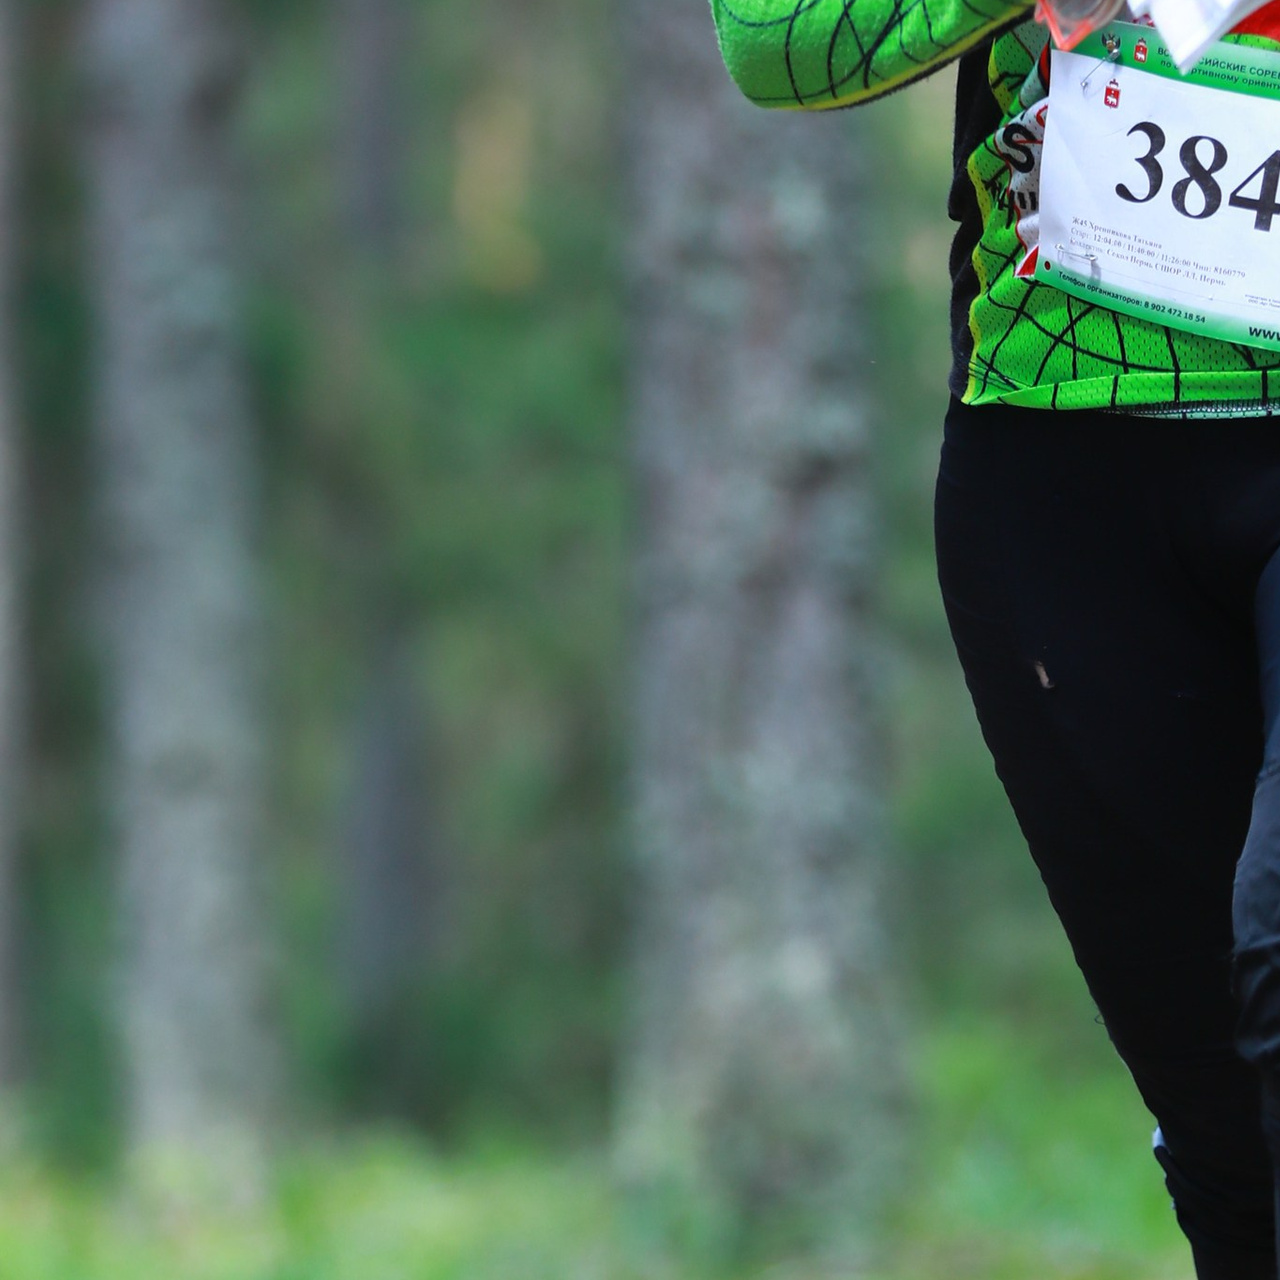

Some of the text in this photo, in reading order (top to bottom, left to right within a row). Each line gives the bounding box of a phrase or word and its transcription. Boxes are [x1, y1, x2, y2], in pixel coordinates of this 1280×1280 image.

[1160, 59, 1172, 68] по
[1058, 271, 1086, 289] Телефон
[1087, 284, 1143, 308] организаторов:
[1151, 302, 1166, 313] 902
[1167, 306, 1182, 318] 472
[1183, 311, 1194, 321] 18
[1195, 315, 1206, 324] 54
